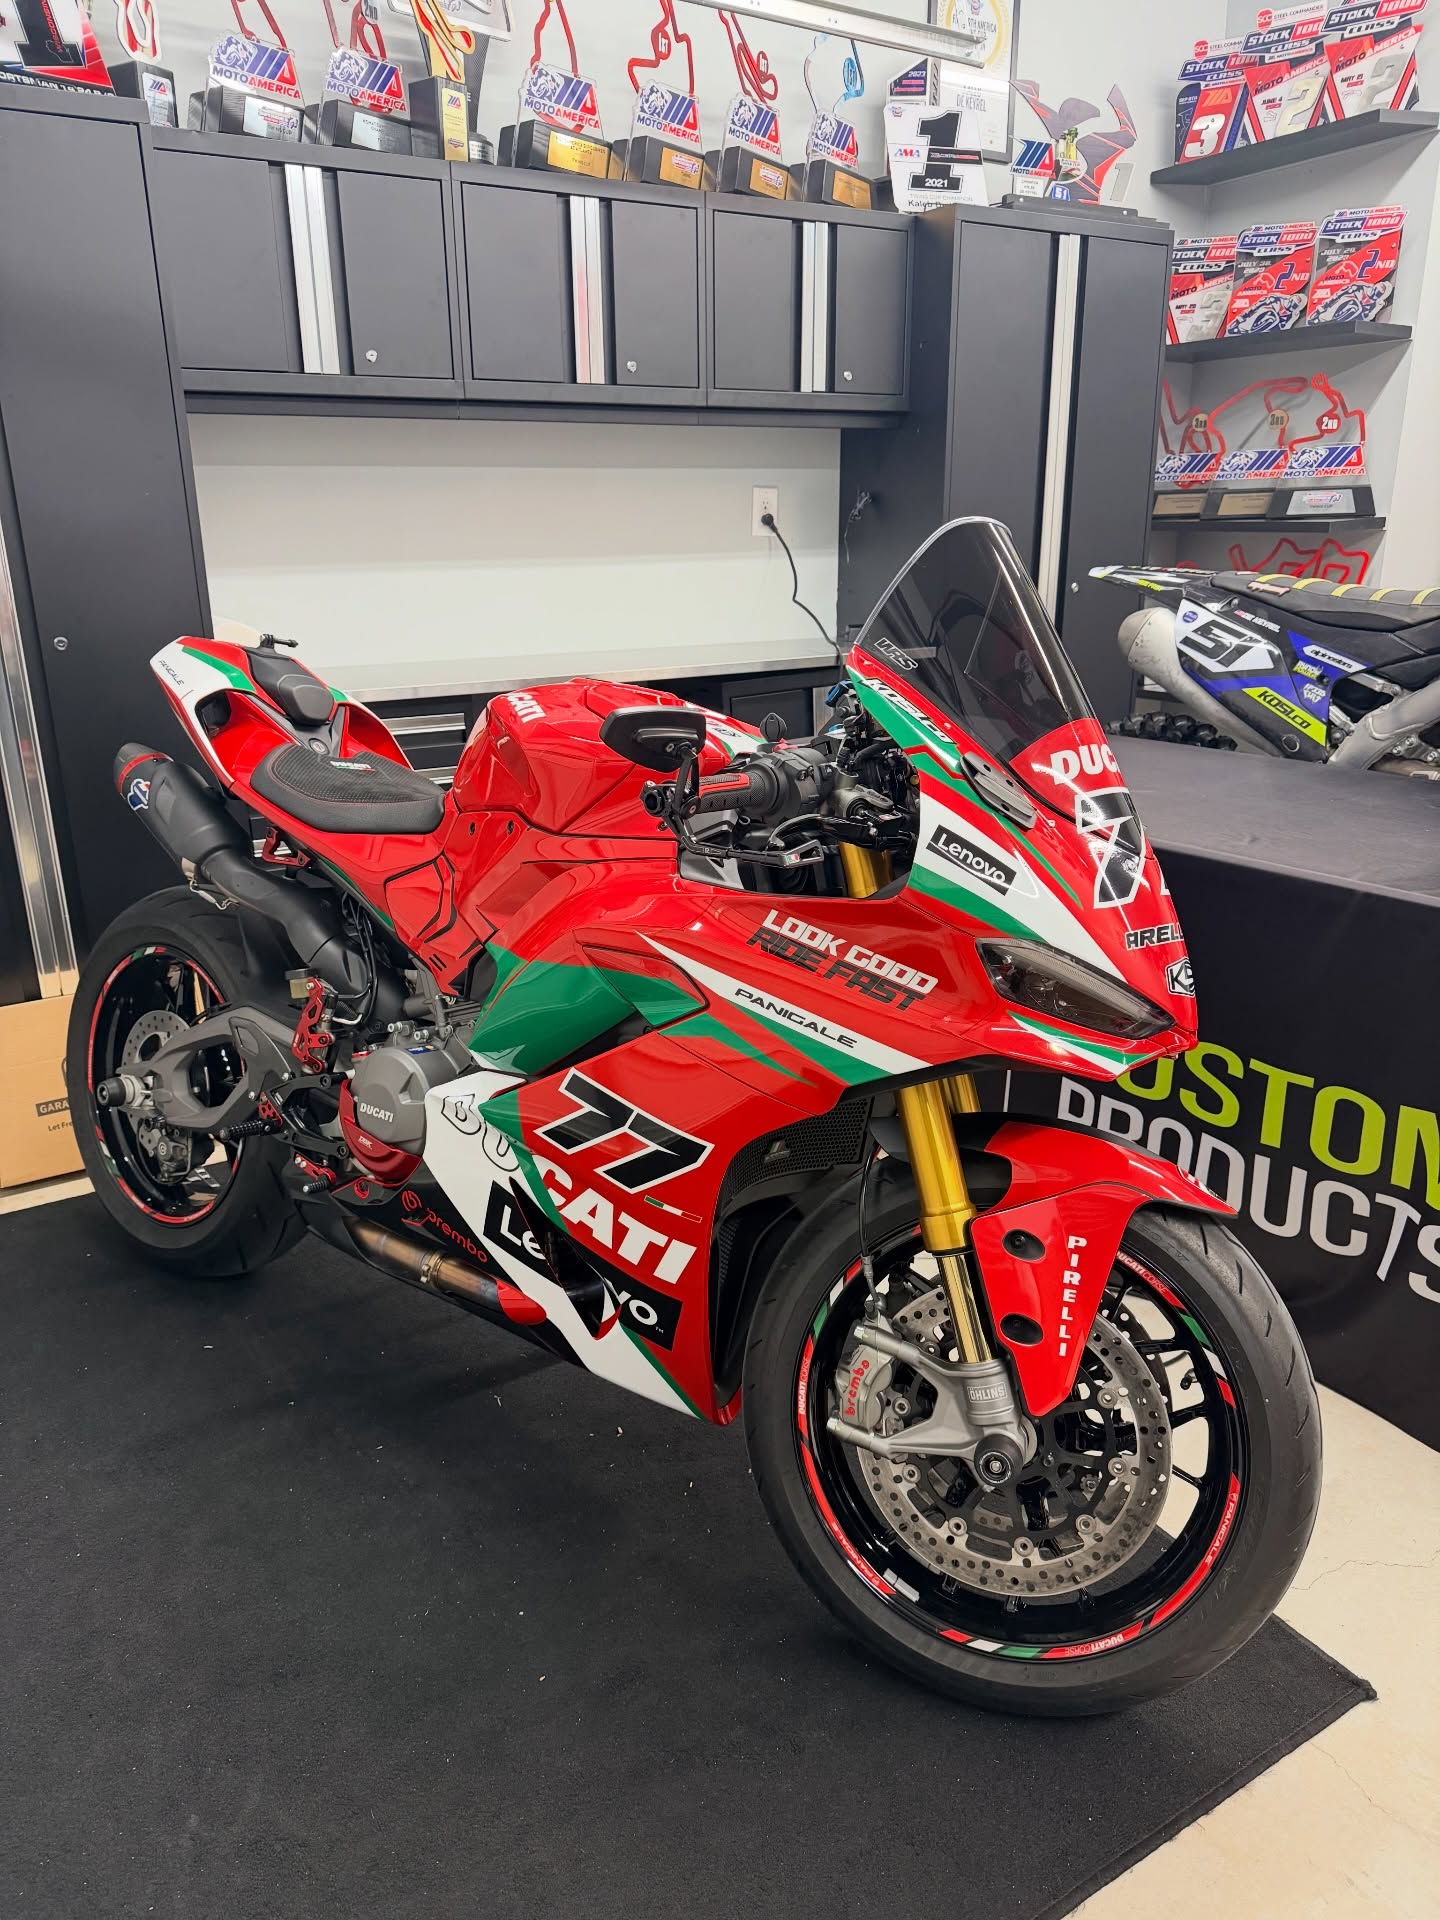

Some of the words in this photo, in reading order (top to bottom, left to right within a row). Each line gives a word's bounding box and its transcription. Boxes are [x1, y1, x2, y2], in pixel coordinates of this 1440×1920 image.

[1328, 5, 1377, 24] STOCK
[1247, 29, 1291, 46] STOCK
[1270, 39, 1310, 53] CLASS
[1335, 26, 1417, 73] MOTOAMERICA
[1184, 60, 1225, 74] STOCK
[1205, 69, 1243, 81] CLASS
[211, 63, 301, 100] MOTOAMERICA
[326, 79, 407, 112] MOTOAMERICA
[523, 97, 601, 129] MOTOAMERICA
[636, 114, 701, 145] MOTOAMERICA
[728, 126, 782, 156] MOTOAMERICA
[1185, 114, 1225, 157] 3
[812, 140, 858, 168] MOTOAMERICA
[894, 148, 920, 158] AMA
[924, 178, 949, 188] 2021
[1012, 167, 1056, 179] MOTOAMERICA
[1055, 187, 1067, 200] 51
[1349, 206, 1401, 215] MOTOAMERICA
[1264, 223, 1314, 231] MOTOAMERICA
[1326, 220, 1363, 231] STOCK
[1366, 216, 1400, 227] 1000
[1242, 235, 1279, 245] STOCK
[1282, 231, 1313, 242] 1000
[1320, 248, 1341, 256] JULY
[1357, 249, 1395, 279] 2ND
[1182, 262, 1223, 271] CLASS
[1274, 261, 1311, 290] 2ND
[1321, 416, 1339, 430] 2ND
[1283, 466, 1365, 478] MOTOAMERICA
[1179, 619, 1255, 669] 51
[1310, 649, 1353, 669] alpinestars
[507, 692, 547, 723] CATI
[938, 832, 1006, 883] Lenovo
[762, 908, 848, 957] LOOK
[843, 944, 939, 995] GOOD
[745, 926, 830, 973] RIDE
[823, 959, 927, 1012] FAST
[734, 988, 858, 1050] PANIGALE
[360, 1102, 394, 1123] DUCATI
[48, 1123, 61, 1132] Let
[533, 1068, 715, 1194] 77
[1117, 1041, 1440, 1212] USTOM
[1057, 1234, 1087, 1358] PIRELLI
[843, 1359, 871, 1417] brembo
[969, 1385, 1005, 1401] ÖHLINS
[1204, 1501, 1238, 1564] PANIGALE
